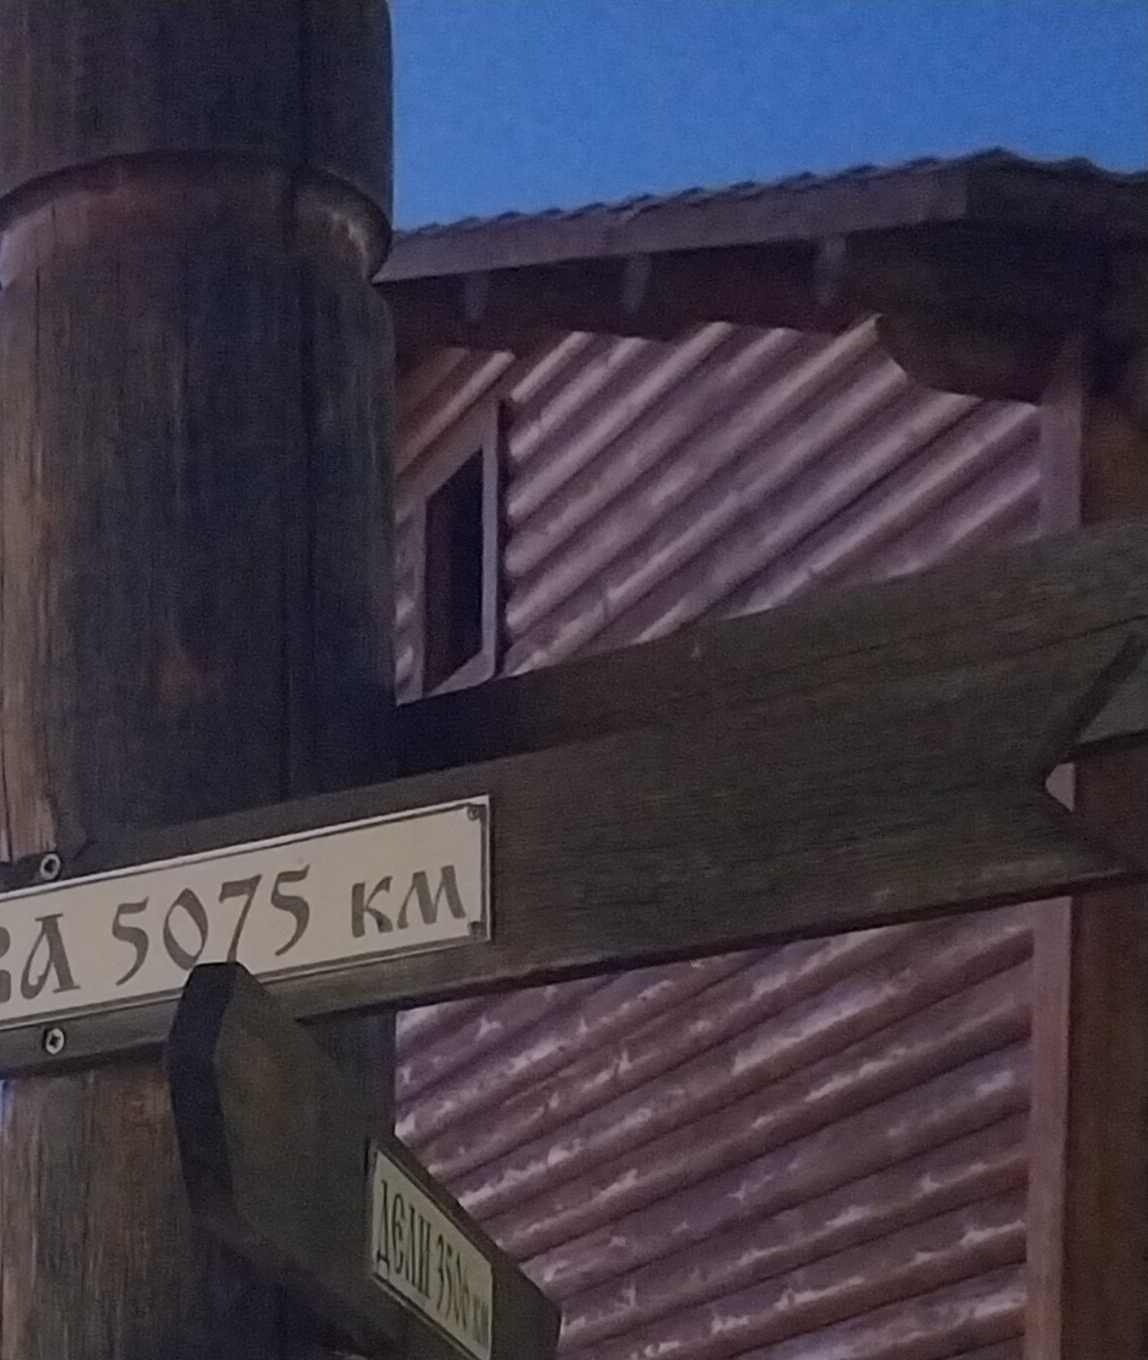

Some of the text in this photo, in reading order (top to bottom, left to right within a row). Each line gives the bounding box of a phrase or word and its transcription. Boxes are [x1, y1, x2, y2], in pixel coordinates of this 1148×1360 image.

[111, 863, 312, 986] 5075
[351, 864, 467, 940] км
[376, 1179, 431, 1299] ДЕЛИ
